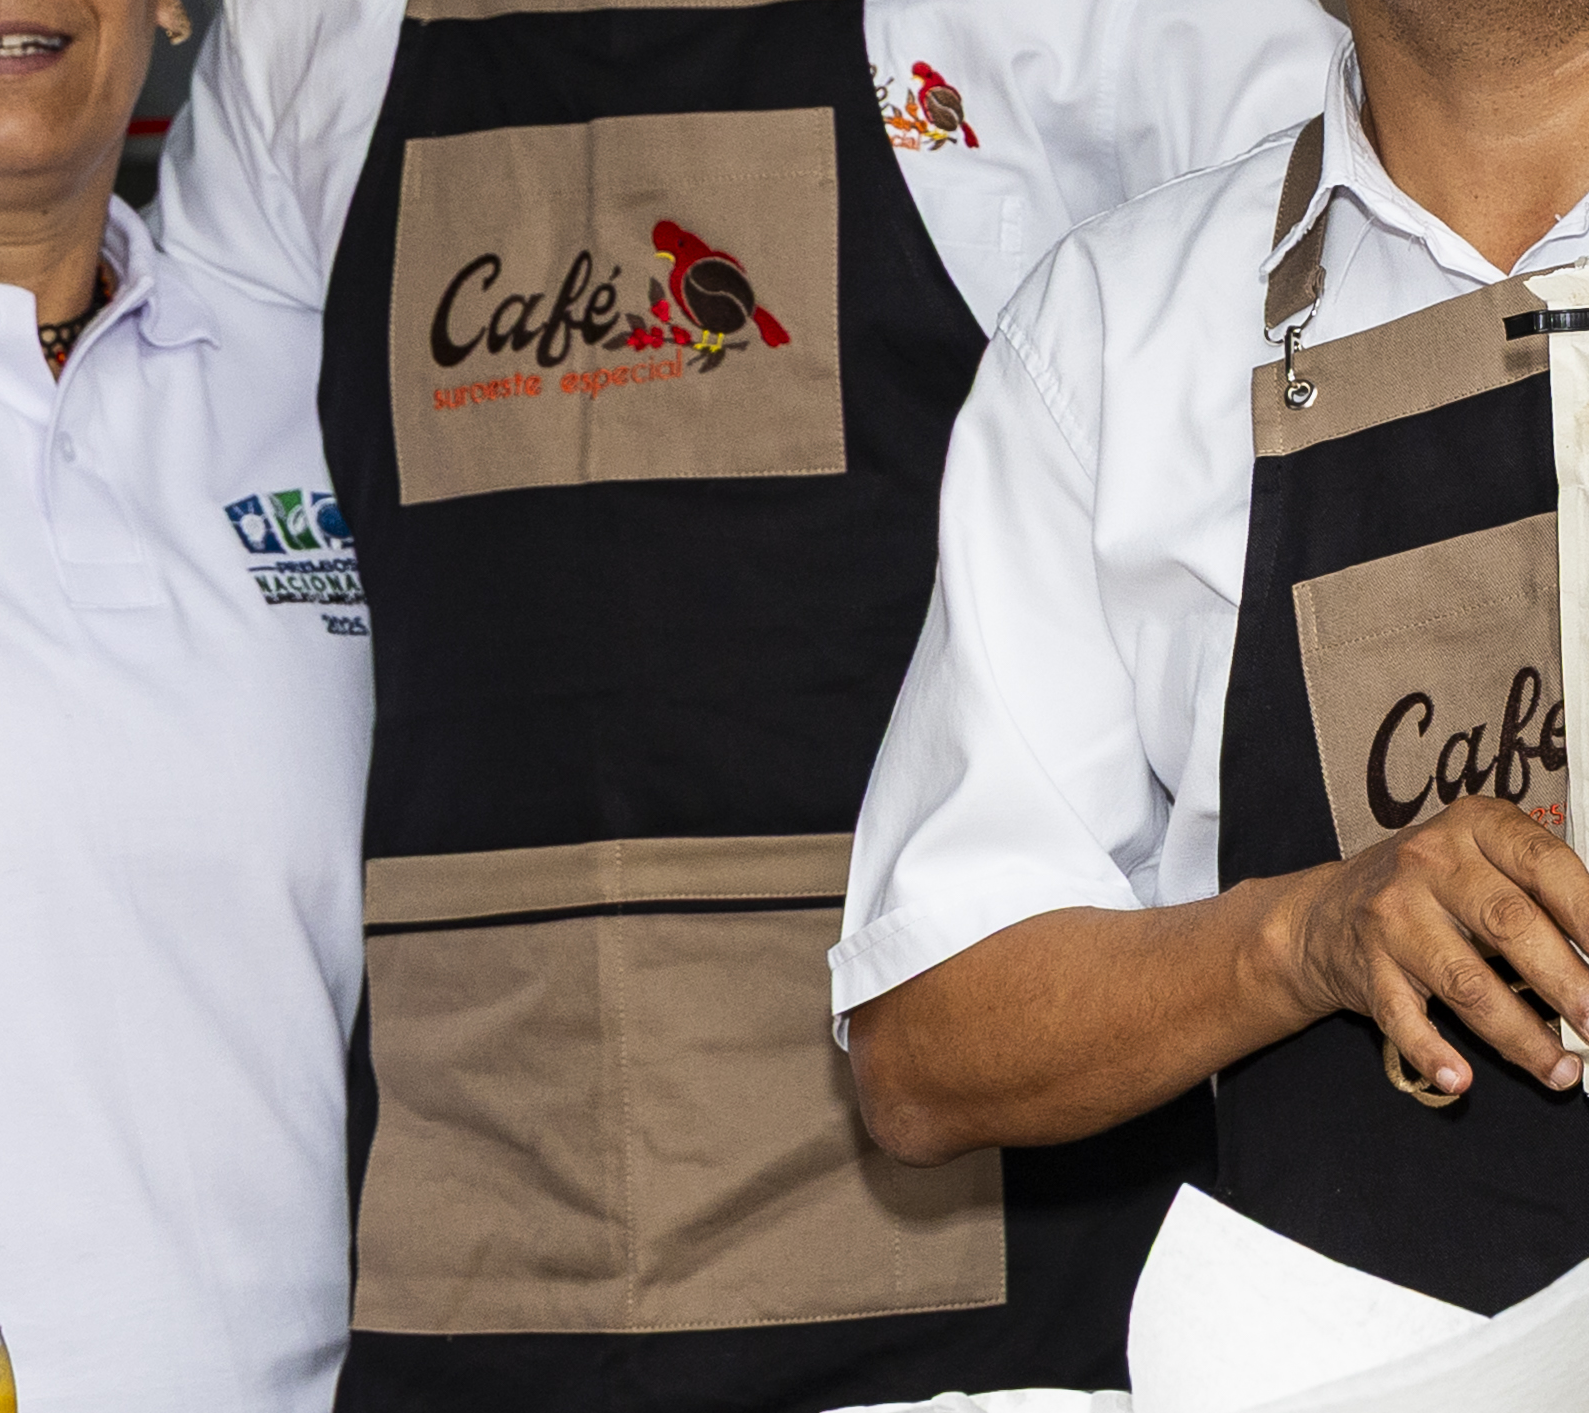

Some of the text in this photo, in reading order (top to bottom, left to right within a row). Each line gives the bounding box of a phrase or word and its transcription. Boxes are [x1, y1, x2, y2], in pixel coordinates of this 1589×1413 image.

[429, 249, 624, 368] Café
[433, 348, 683, 411] suroeste especial
